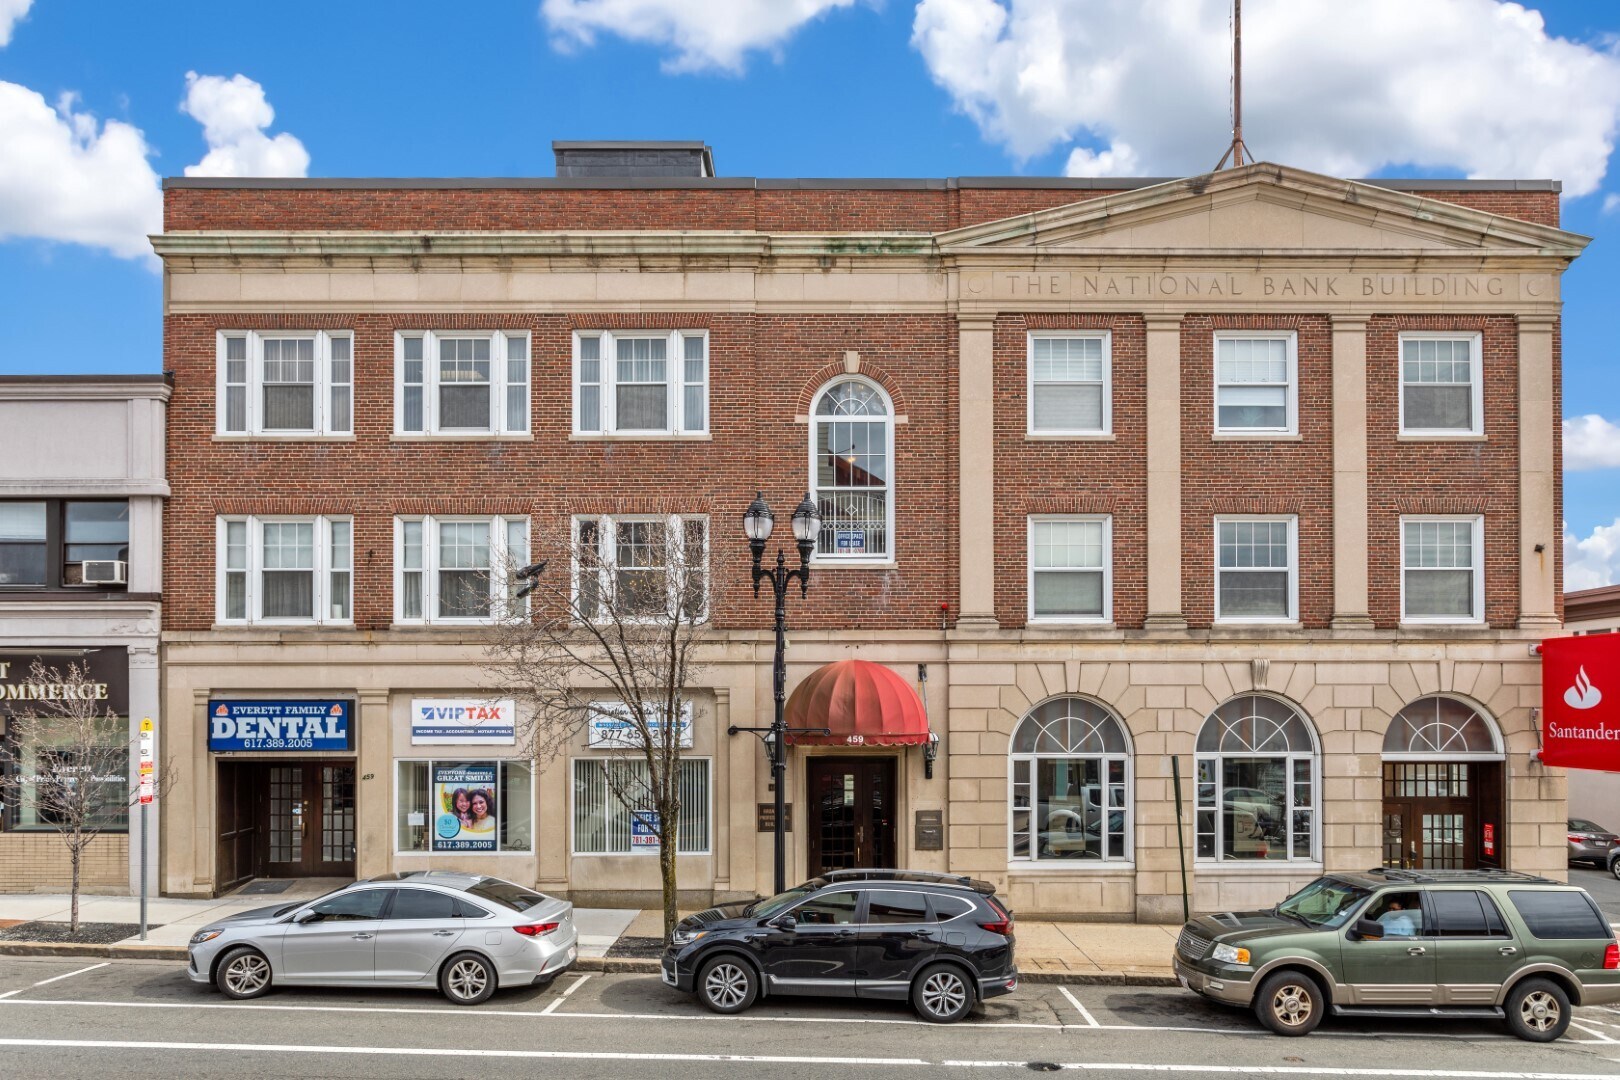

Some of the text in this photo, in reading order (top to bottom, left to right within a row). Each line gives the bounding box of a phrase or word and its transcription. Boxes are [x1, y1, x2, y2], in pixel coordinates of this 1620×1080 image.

[1006, 275, 1504, 297] THE NATIONAL BANK BUILDING
[232, 706, 327, 715] EVERETT FAMILY
[211, 716, 346, 739] DENTAL
[1549, 722, 1620, 741] Santander
[243, 738, 313, 748] 617.389.2005
[846, 735, 864, 743] 459
[361, 773, 375, 781] 459
[437, 840, 493, 849] 617.389.2005
